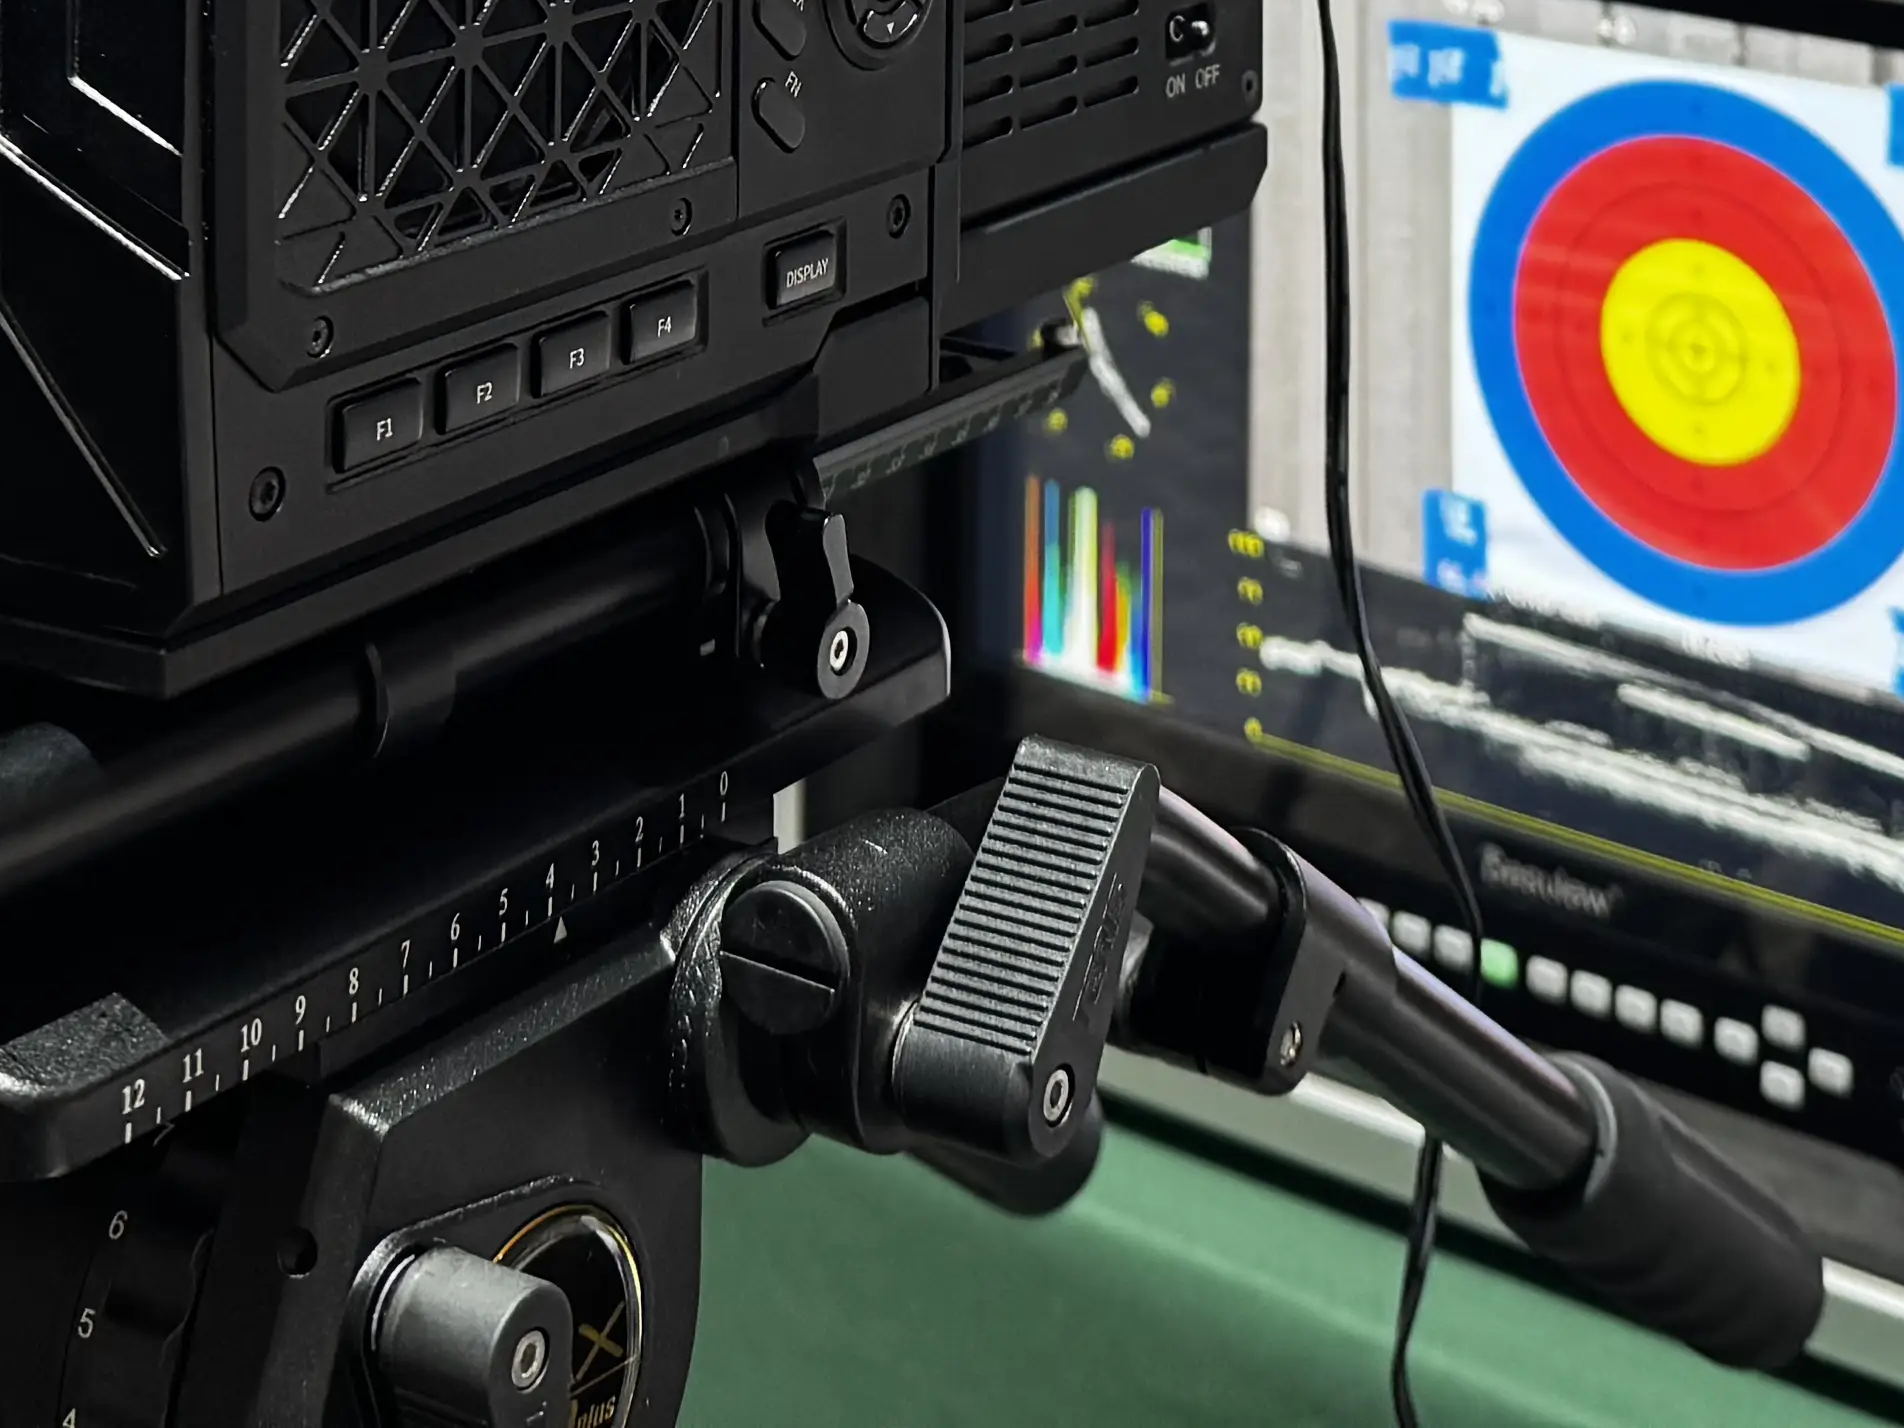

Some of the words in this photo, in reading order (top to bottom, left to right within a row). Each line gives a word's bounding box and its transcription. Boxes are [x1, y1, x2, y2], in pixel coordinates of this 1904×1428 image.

[784, 70, 803, 99] FN
[1165, 72, 1186, 98] ON
[1194, 63, 1221, 90] OFF
[785, 256, 829, 290] DISPLAY
[656, 314, 673, 338] F4
[569, 346, 585, 370] F3
[476, 381, 493, 405] F2
[375, 417, 394, 442] F1
[122, 1078, 146, 1115] 12
[182, 1047, 205, 1083] 11
[240, 1017, 262, 1053] 10
[295, 994, 307, 1026] 9
[348, 967, 360, 996] 8
[400, 939, 412, 969] 7
[450, 912, 461, 942] 6
[498, 887, 509, 917] 5
[545, 862, 556, 888] 4
[591, 839, 600, 866] 3
[635, 815, 644, 842] 2
[719, 770, 730, 796] 0
[108, 1209, 128, 1241] 6
[77, 1307, 96, 1339] 5
